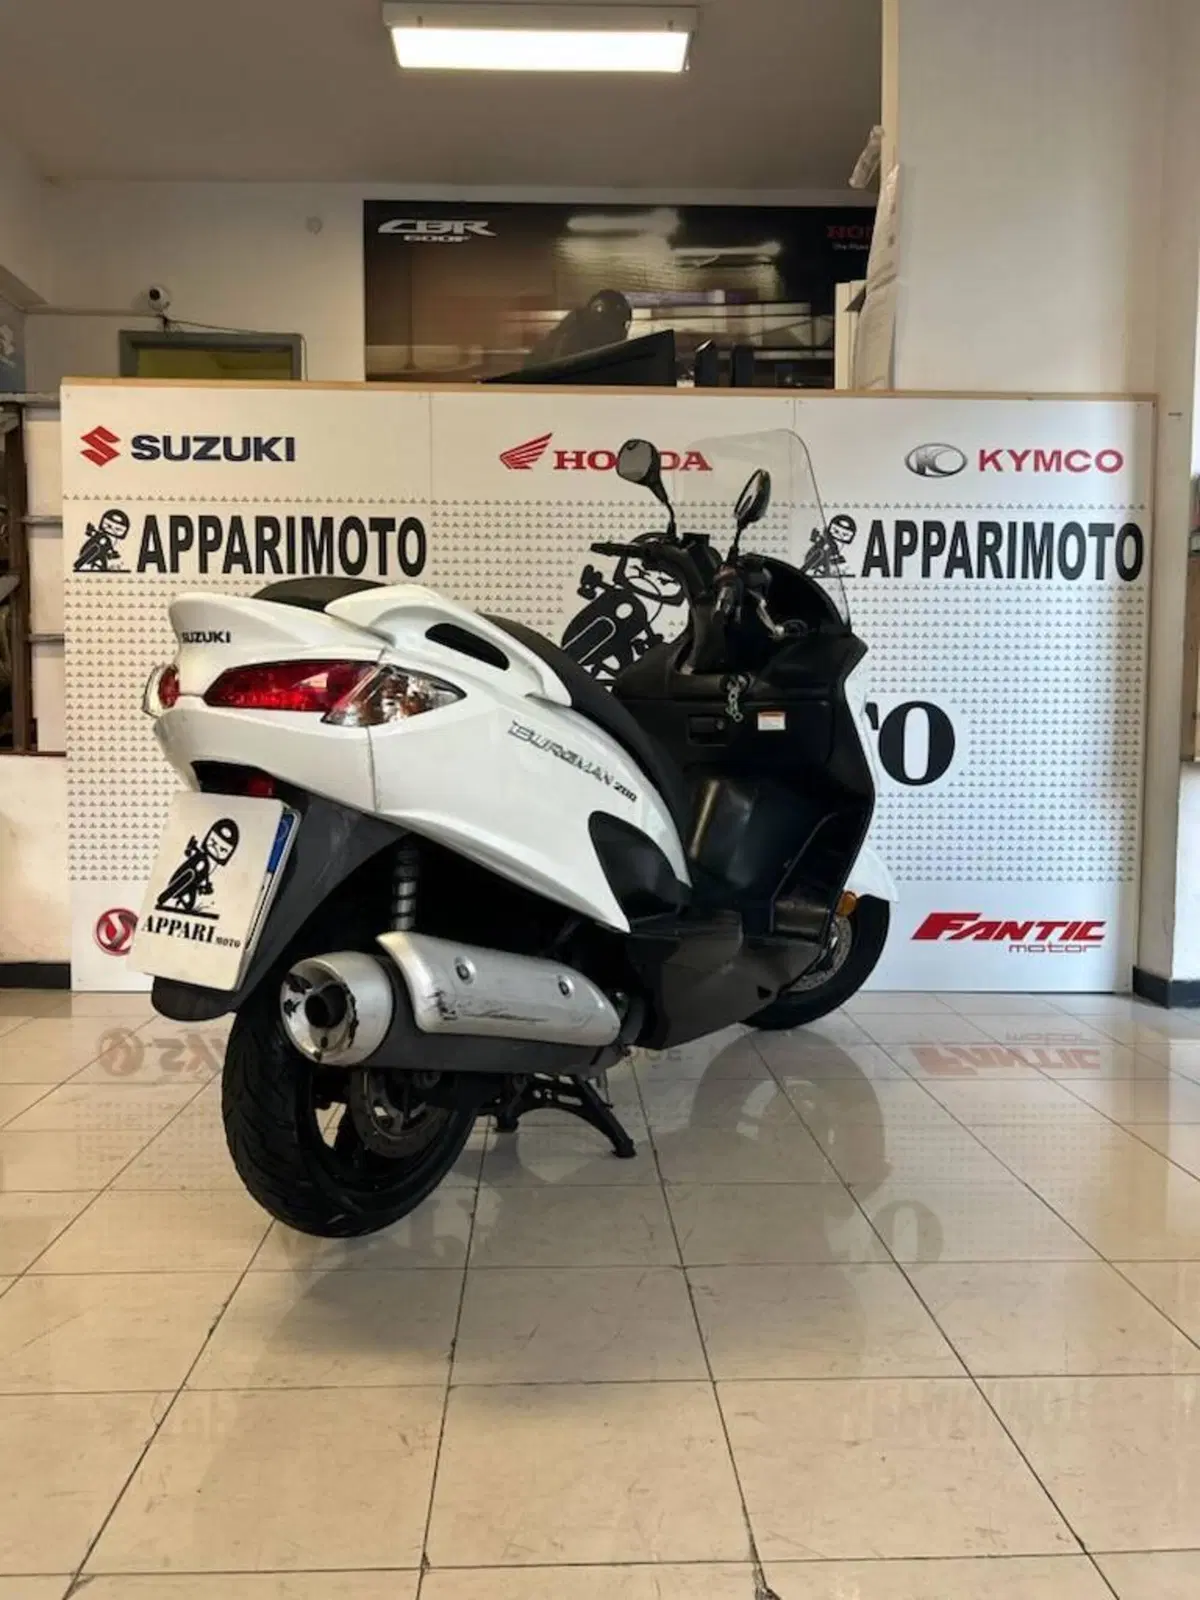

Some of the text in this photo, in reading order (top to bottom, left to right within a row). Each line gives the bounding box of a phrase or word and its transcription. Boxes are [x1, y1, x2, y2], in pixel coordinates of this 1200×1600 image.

[378, 219, 497, 237] CBR
[131, 434, 296, 462] SUZUKI
[553, 449, 713, 471] HODA
[978, 449, 1124, 473] KYMCO
[137, 515, 427, 577] APPARIMOTO
[861, 519, 1145, 581] APPARIMOTO
[182, 630, 231, 644] SUZUKI
[507, 719, 638, 803] BURGMAN 200
[141, 915, 216, 943] APPARI
[910, 912, 1107, 941] FANTIC
[1008, 943, 1102, 954] motor
